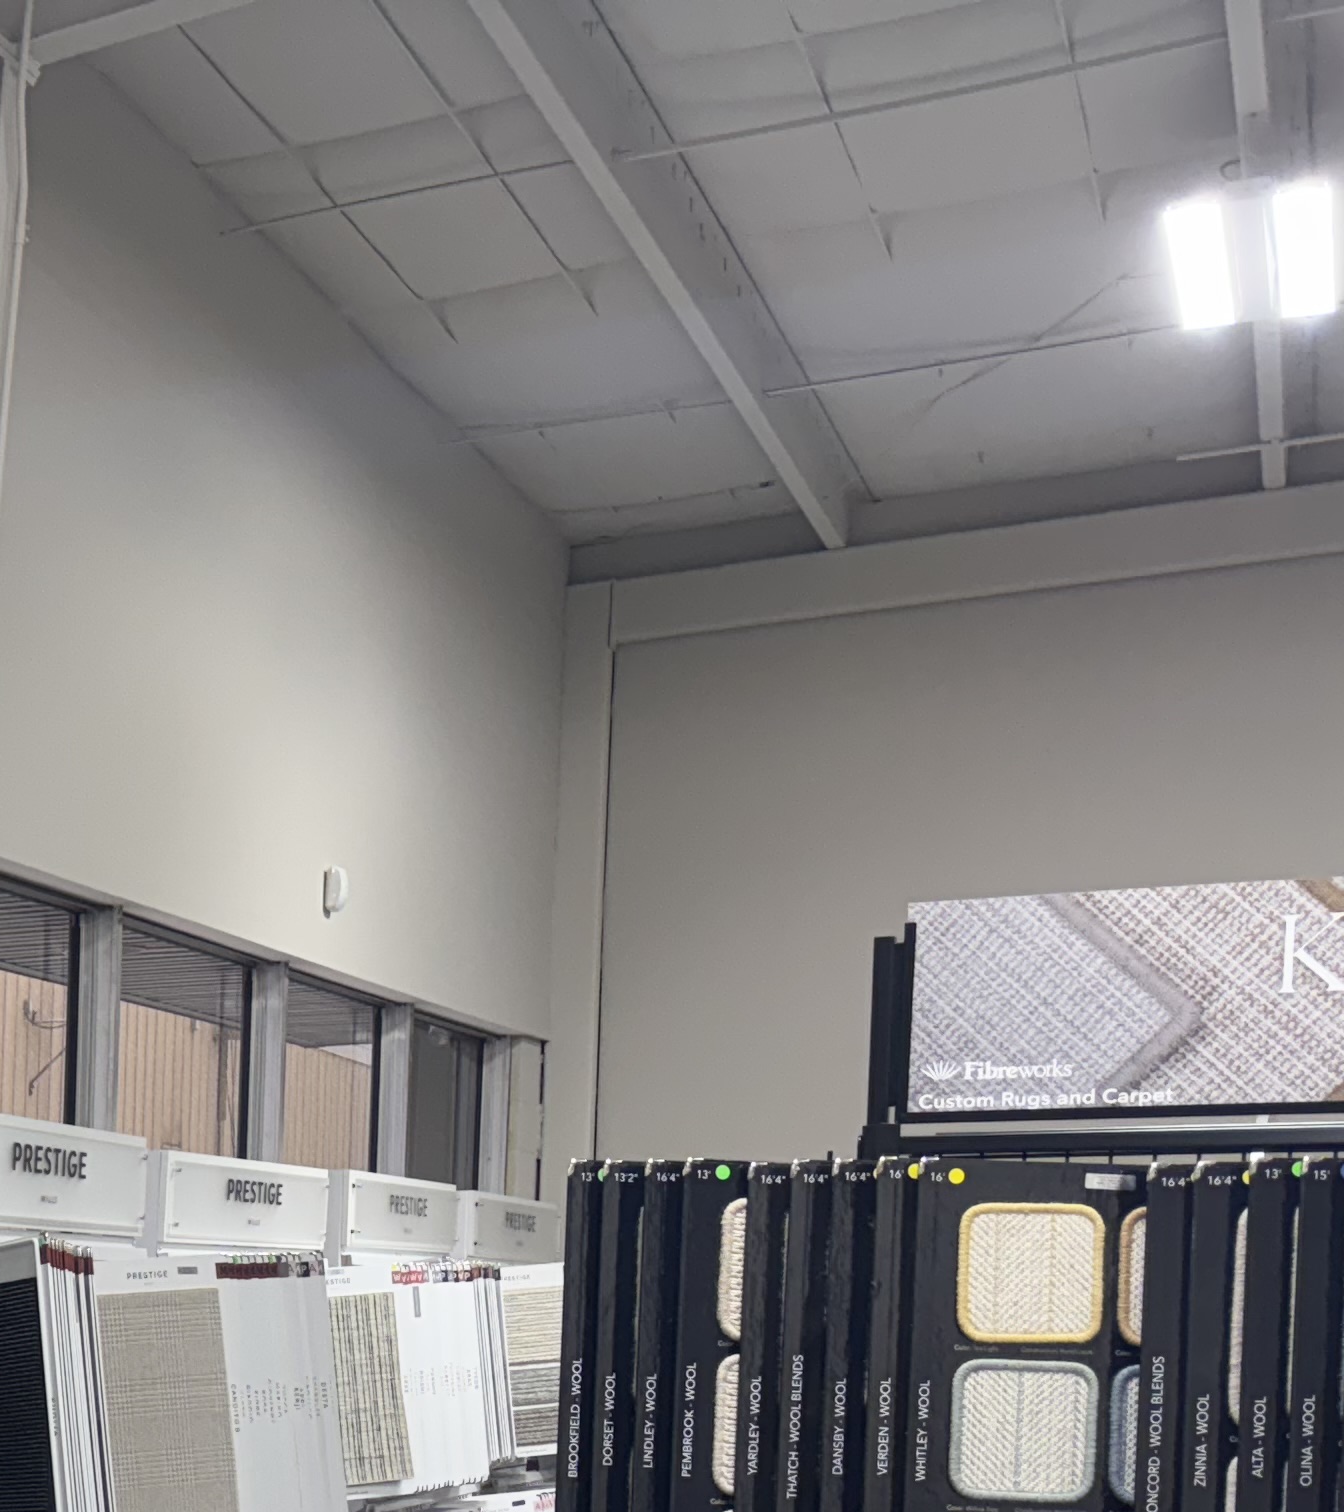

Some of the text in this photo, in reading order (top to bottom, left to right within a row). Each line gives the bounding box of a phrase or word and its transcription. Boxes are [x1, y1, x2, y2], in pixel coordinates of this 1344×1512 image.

[918, 1087, 1174, 1110] Custom Rugs and Carpet
[963, 1059, 1074, 1080] Fibreworks
[11, 1141, 88, 1180] PRESTIGE
[227, 1178, 283, 1206] PRESTIGE
[389, 1194, 428, 1218] PRESTIGE
[504, 1211, 536, 1233] PRESTIGE
[568, 1358, 582, 1478] BROOKFIELD WOOL
[602, 1372, 616, 1466] DORSET WOOL
[681, 1362, 697, 1477] PEMBROOK WOOL
[747, 1376, 762, 1476] YARDLEY WOOL
[786, 1354, 804, 1499] THATCH WOOL BLENDS
[832, 1378, 847, 1475] DANSBY WOOL
[877, 1377, 892, 1476] VERDEN WOOL
[1149, 1407, 1163, 1447] WOOL
[1151, 1356, 1165, 1405] BLENDS
[915, 1380, 931, 1481] WHITLEY WOOL
[1194, 1394, 1210, 1487] ZINNIA WOOL
[1252, 1396, 1267, 1478] ALTA WOOL
[1299, 1394, 1316, 1487] OLINA WOOL
